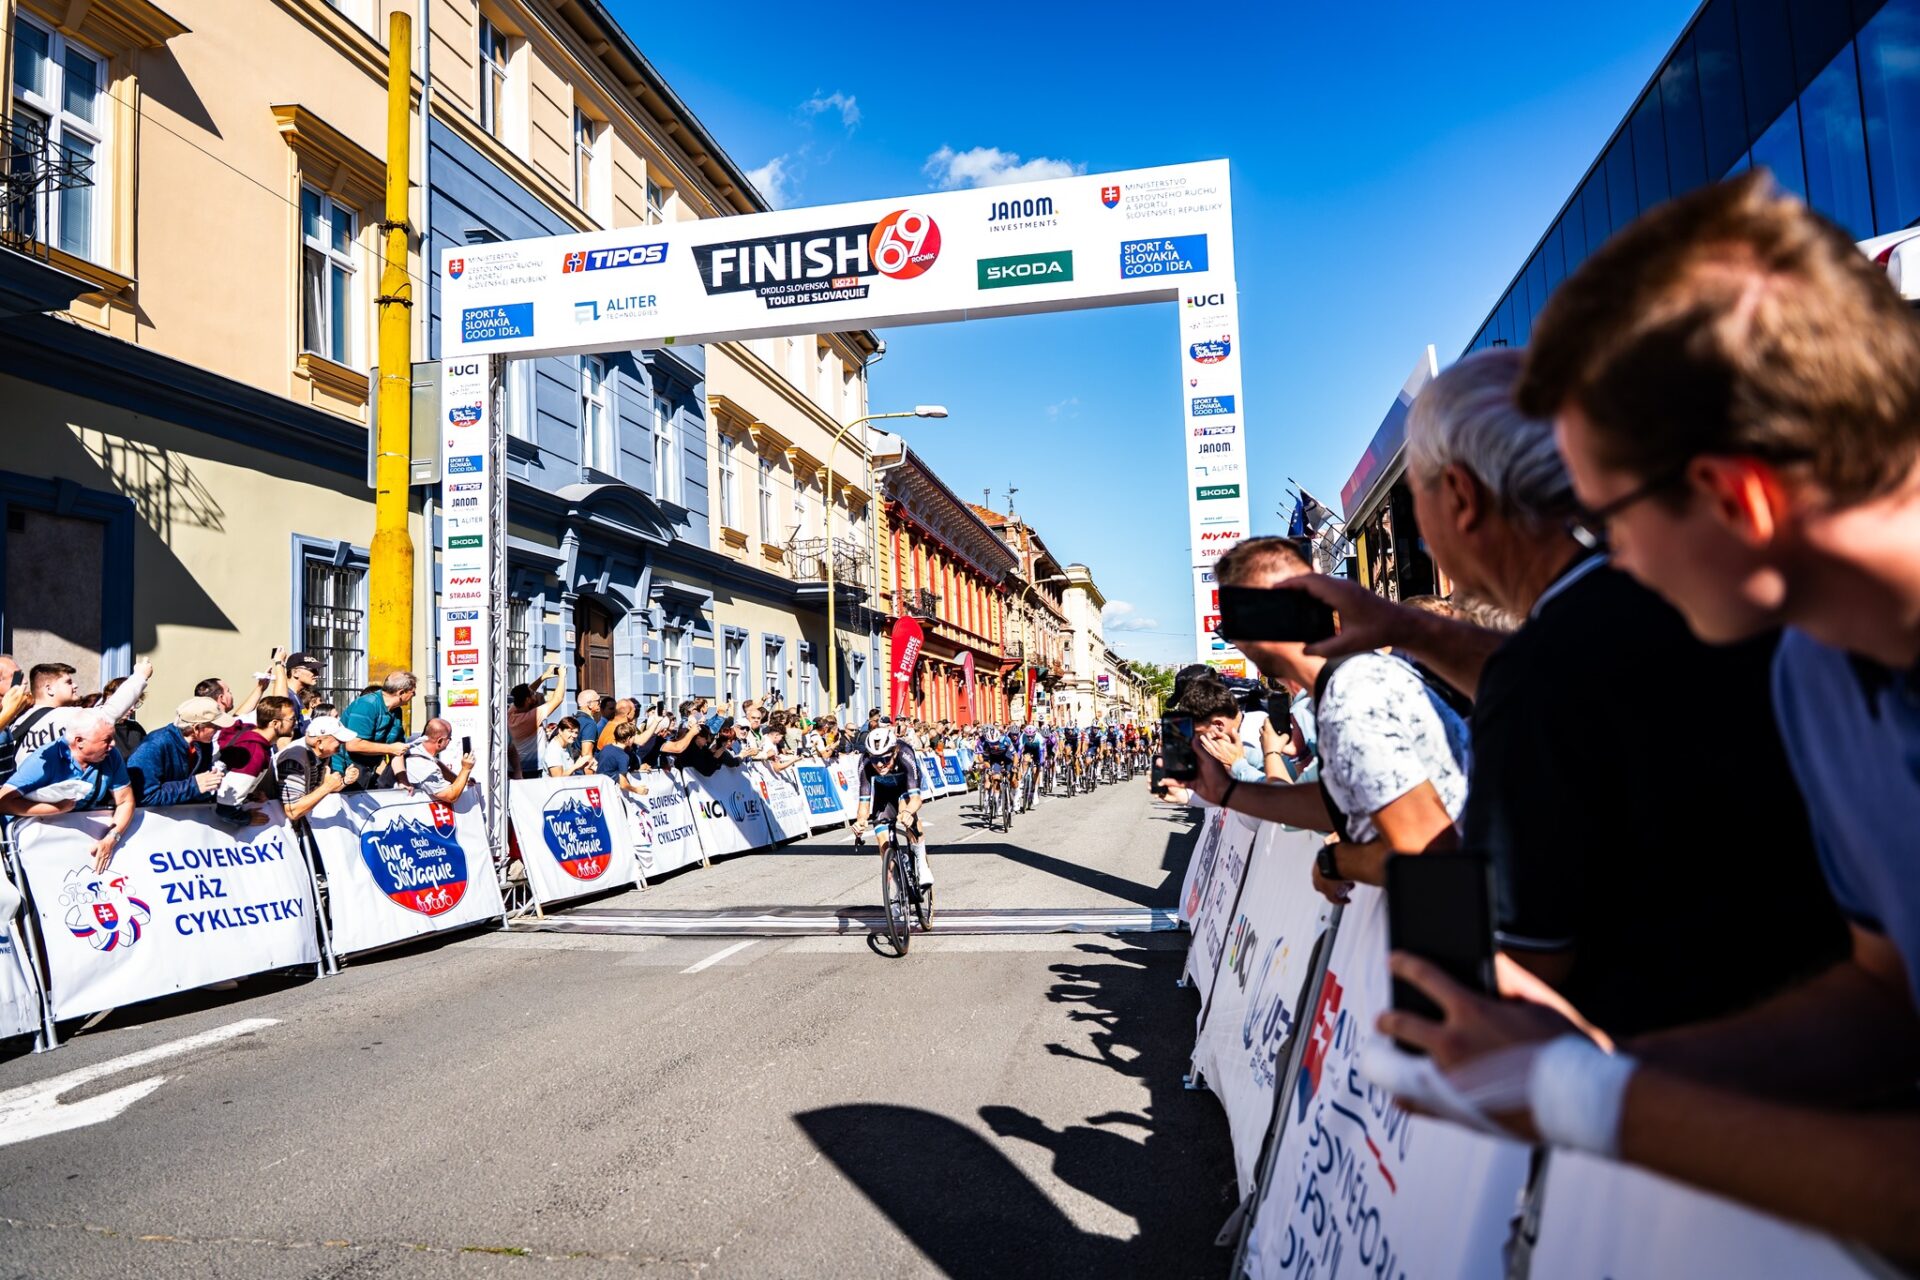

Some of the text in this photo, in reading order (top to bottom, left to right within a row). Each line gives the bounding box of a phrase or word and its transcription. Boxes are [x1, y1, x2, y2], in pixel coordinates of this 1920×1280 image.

[1126, 178, 1186, 190] MINISTERSTVO
[1185, 187, 1216, 196] RUCHU
[1178, 203, 1222, 214] REPUBLIKY
[990, 219, 1058, 232] INVESTMENTS
[875, 209, 930, 274] 69
[1124, 240, 1174, 254] SPORT &
[592, 245, 664, 268] TIPOS
[712, 234, 868, 287] FINISH
[1124, 251, 1180, 264] SLOVAKIA
[1125, 260, 1192, 275] GOOD IDEA
[760, 286, 786, 295] OKOLO
[786, 282, 830, 292] SLOVENSKA
[606, 294, 657, 311] ALITER
[768, 288, 866, 306] TOUR DE SLOVAQUIE
[1194, 294, 1224, 306] UCI
[465, 308, 506, 320] SPORT &
[606, 310, 658, 320] TECHNOLOGIES
[465, 318, 510, 330] SLOVAKIA
[466, 326, 520, 340] GOOD IDEA
[454, 364, 478, 376] UCI
[1198, 442, 1230, 454] JANOM
[1212, 464, 1238, 472] ALITER
[452, 497, 478, 507] JANOM
[900, 636, 917, 671] PIERRE
[546, 815, 571, 838] Tour
[410, 836, 429, 848] Okolo
[568, 829, 579, 843] de
[367, 836, 403, 863] Tour
[416, 846, 446, 860] Slovenska
[558, 834, 602, 860] Slovaquie
[150, 836, 284, 873] SLOVENSKÝ
[400, 852, 416, 872] de
[388, 858, 455, 890] Slovaquie
[161, 874, 228, 904] ZVÄZ
[176, 898, 304, 936] CYKLISTIKY
